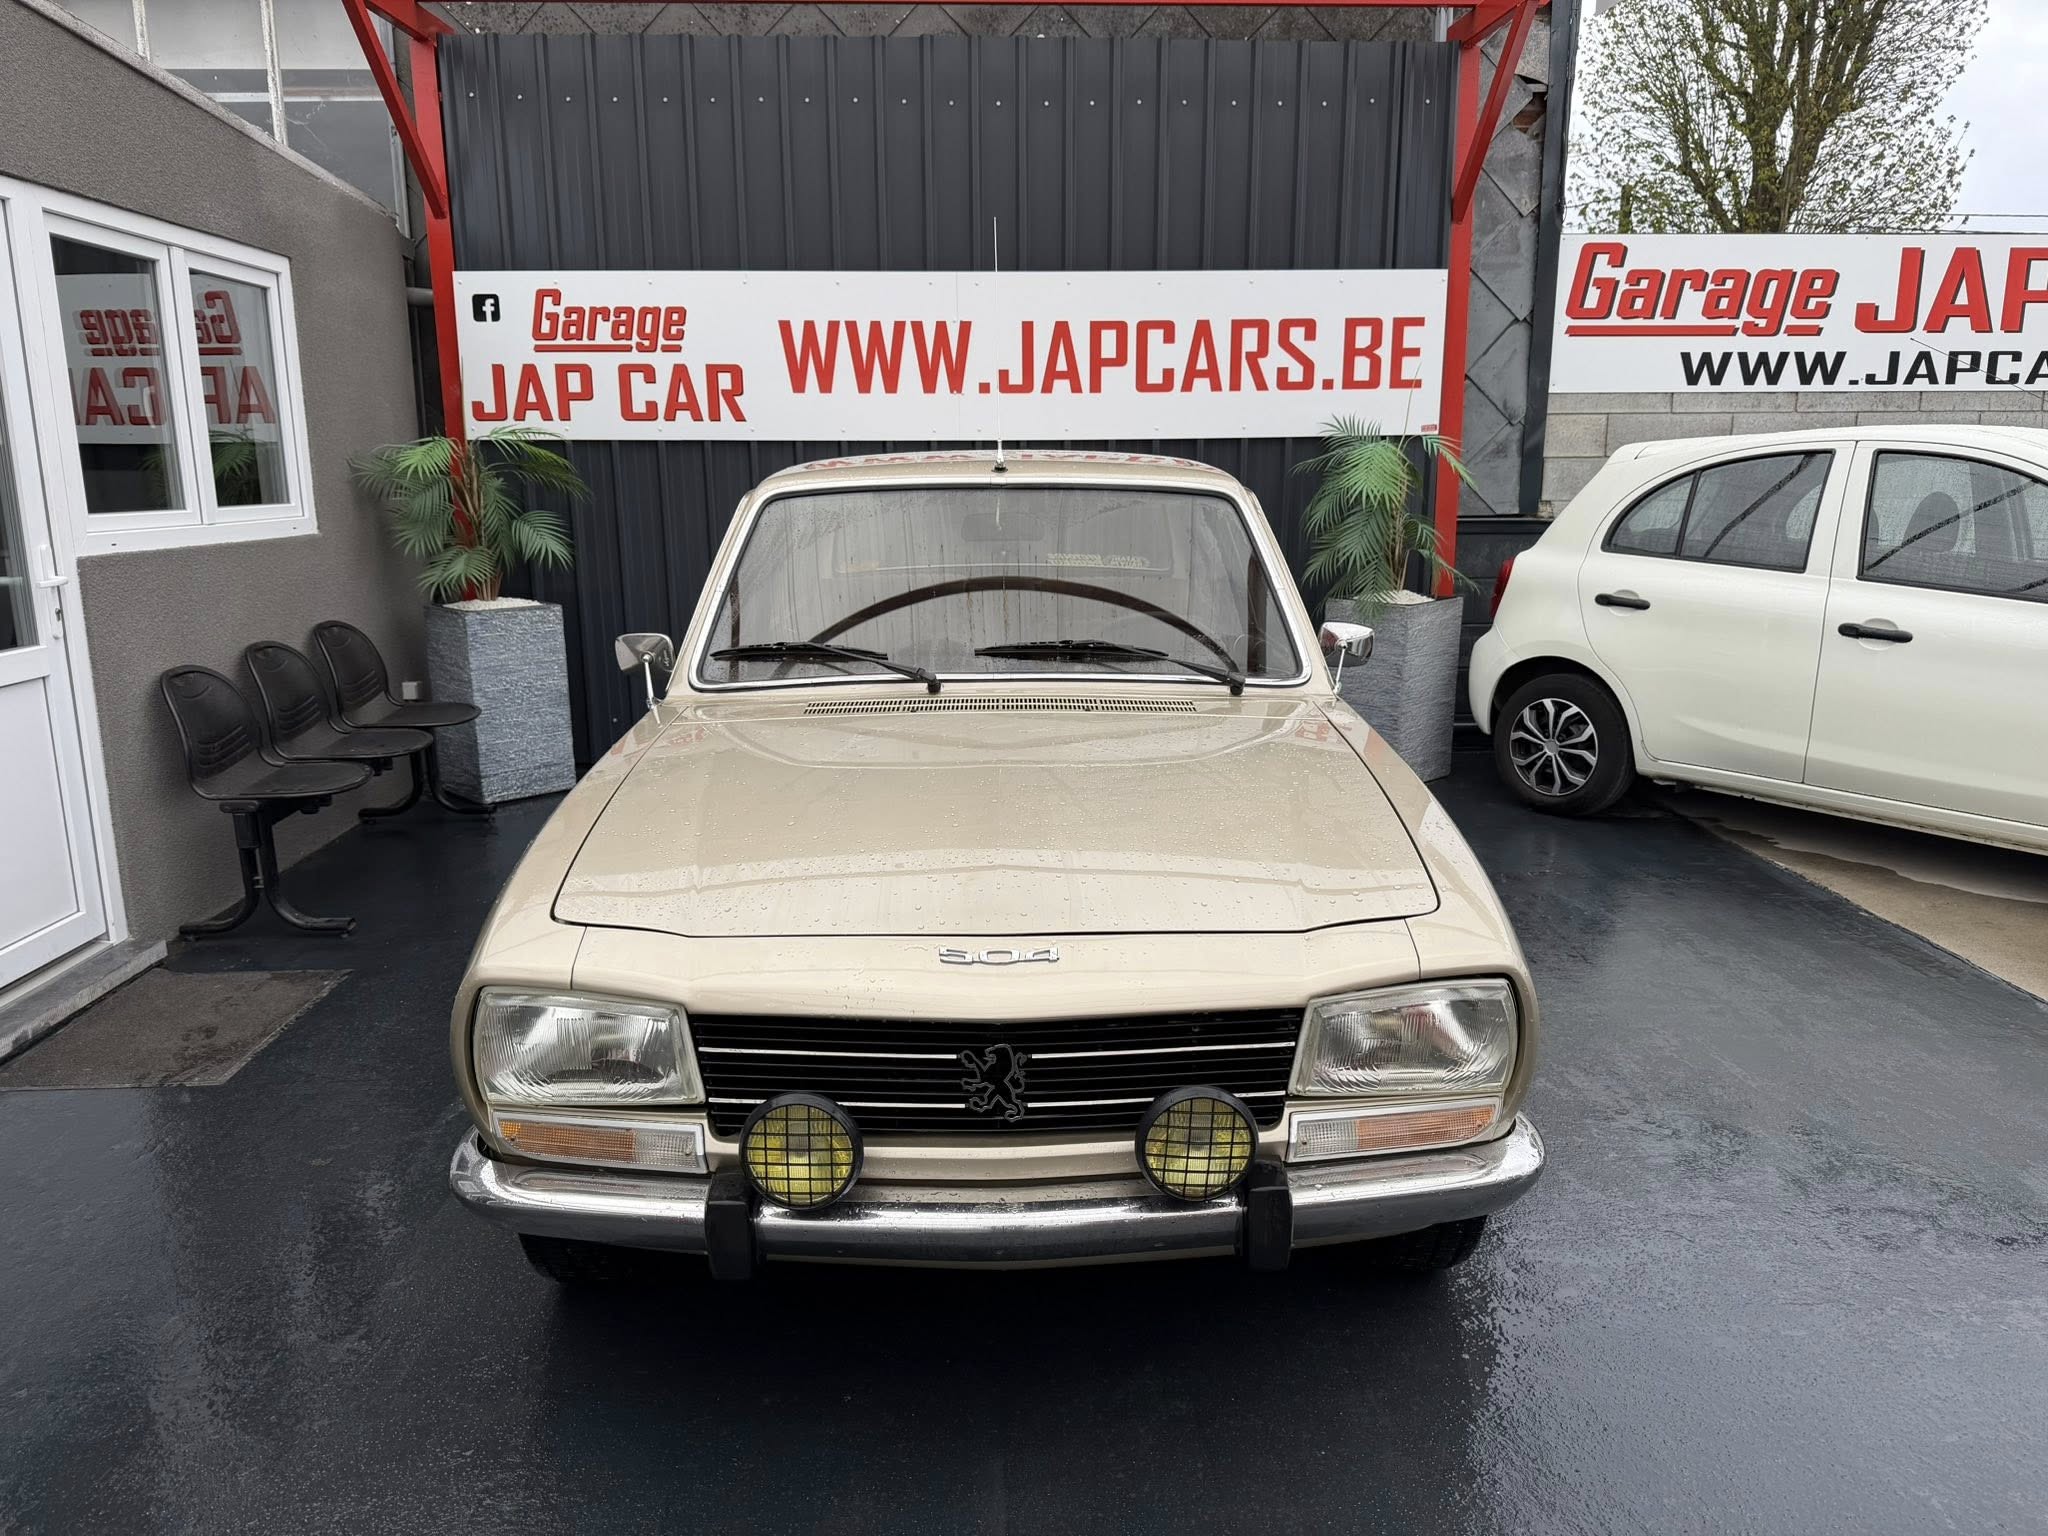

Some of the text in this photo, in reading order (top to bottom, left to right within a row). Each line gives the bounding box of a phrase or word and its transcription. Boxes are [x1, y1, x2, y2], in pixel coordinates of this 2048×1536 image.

[531, 288, 687, 353] Garage
[1565, 242, 2048, 337] Garage JAP
[777, 316, 1426, 395] WWW.JAPCARS.BE
[471, 363, 747, 423] JAP CAR
[938, 947, 1060, 966] 504
